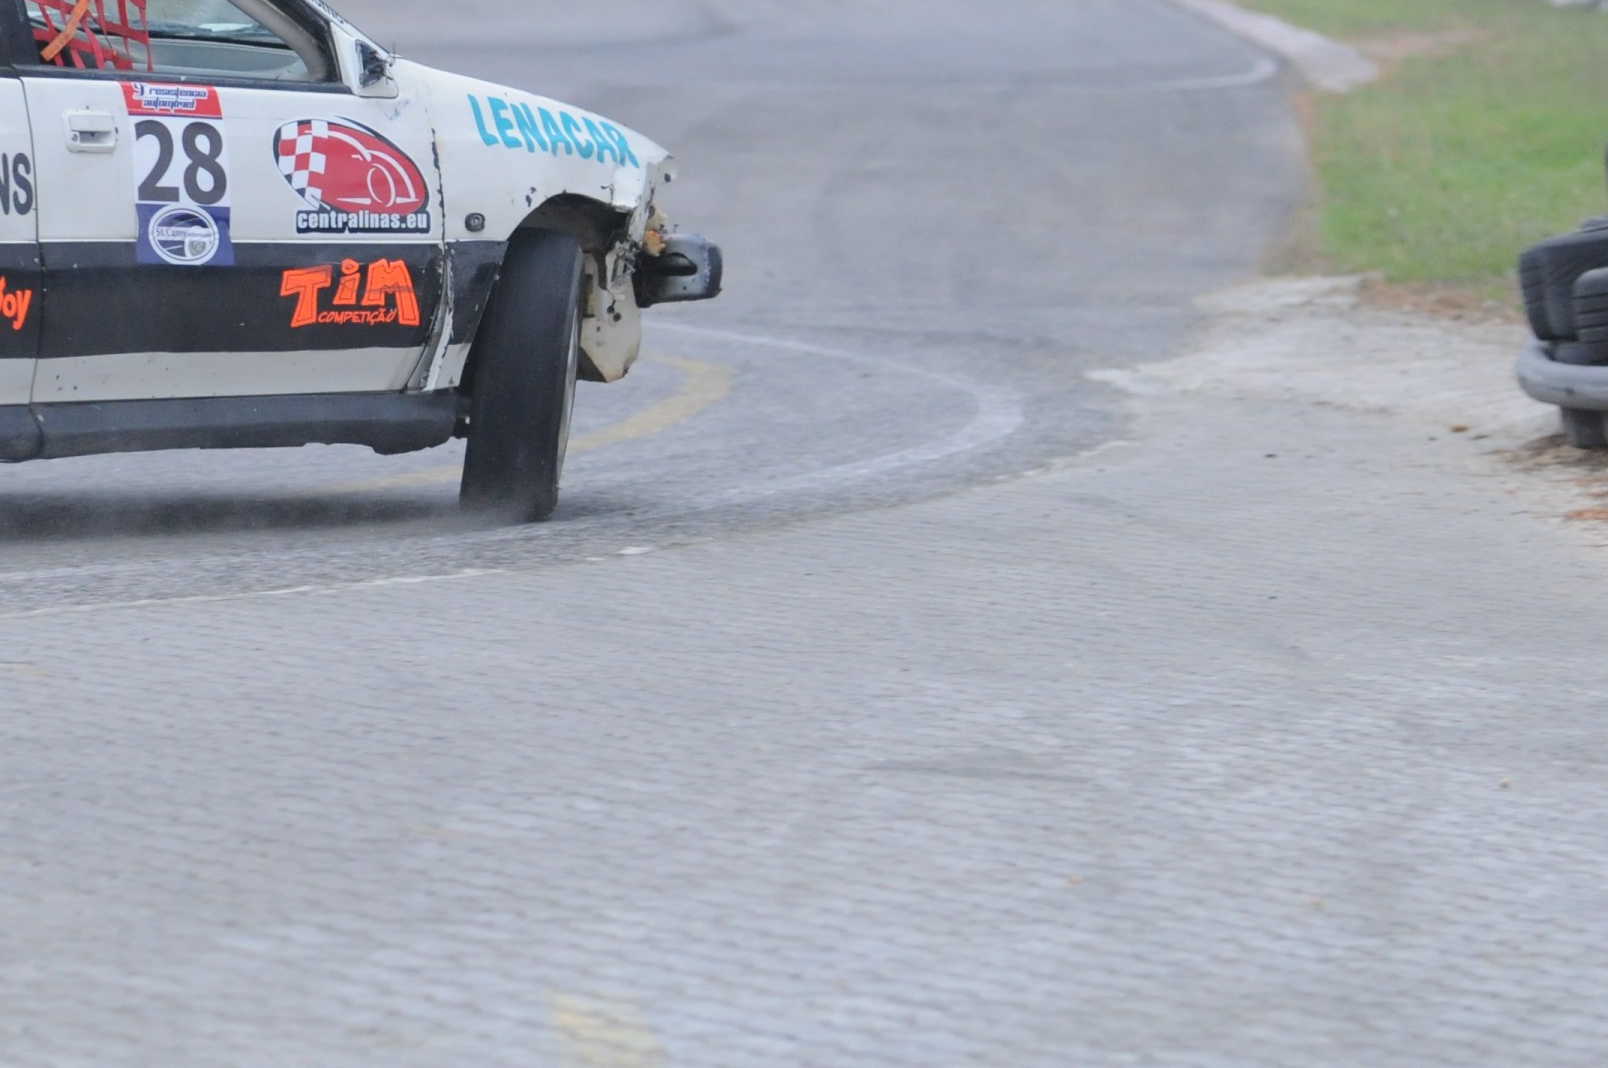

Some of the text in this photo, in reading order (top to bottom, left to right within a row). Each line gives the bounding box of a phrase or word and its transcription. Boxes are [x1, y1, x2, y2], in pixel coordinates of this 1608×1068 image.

[467, 93, 640, 170] LENACAR
[134, 119, 228, 205] 28
[297, 210, 428, 229] centralinas.eu
[317, 308, 398, 326] COMPETIÇÃO
